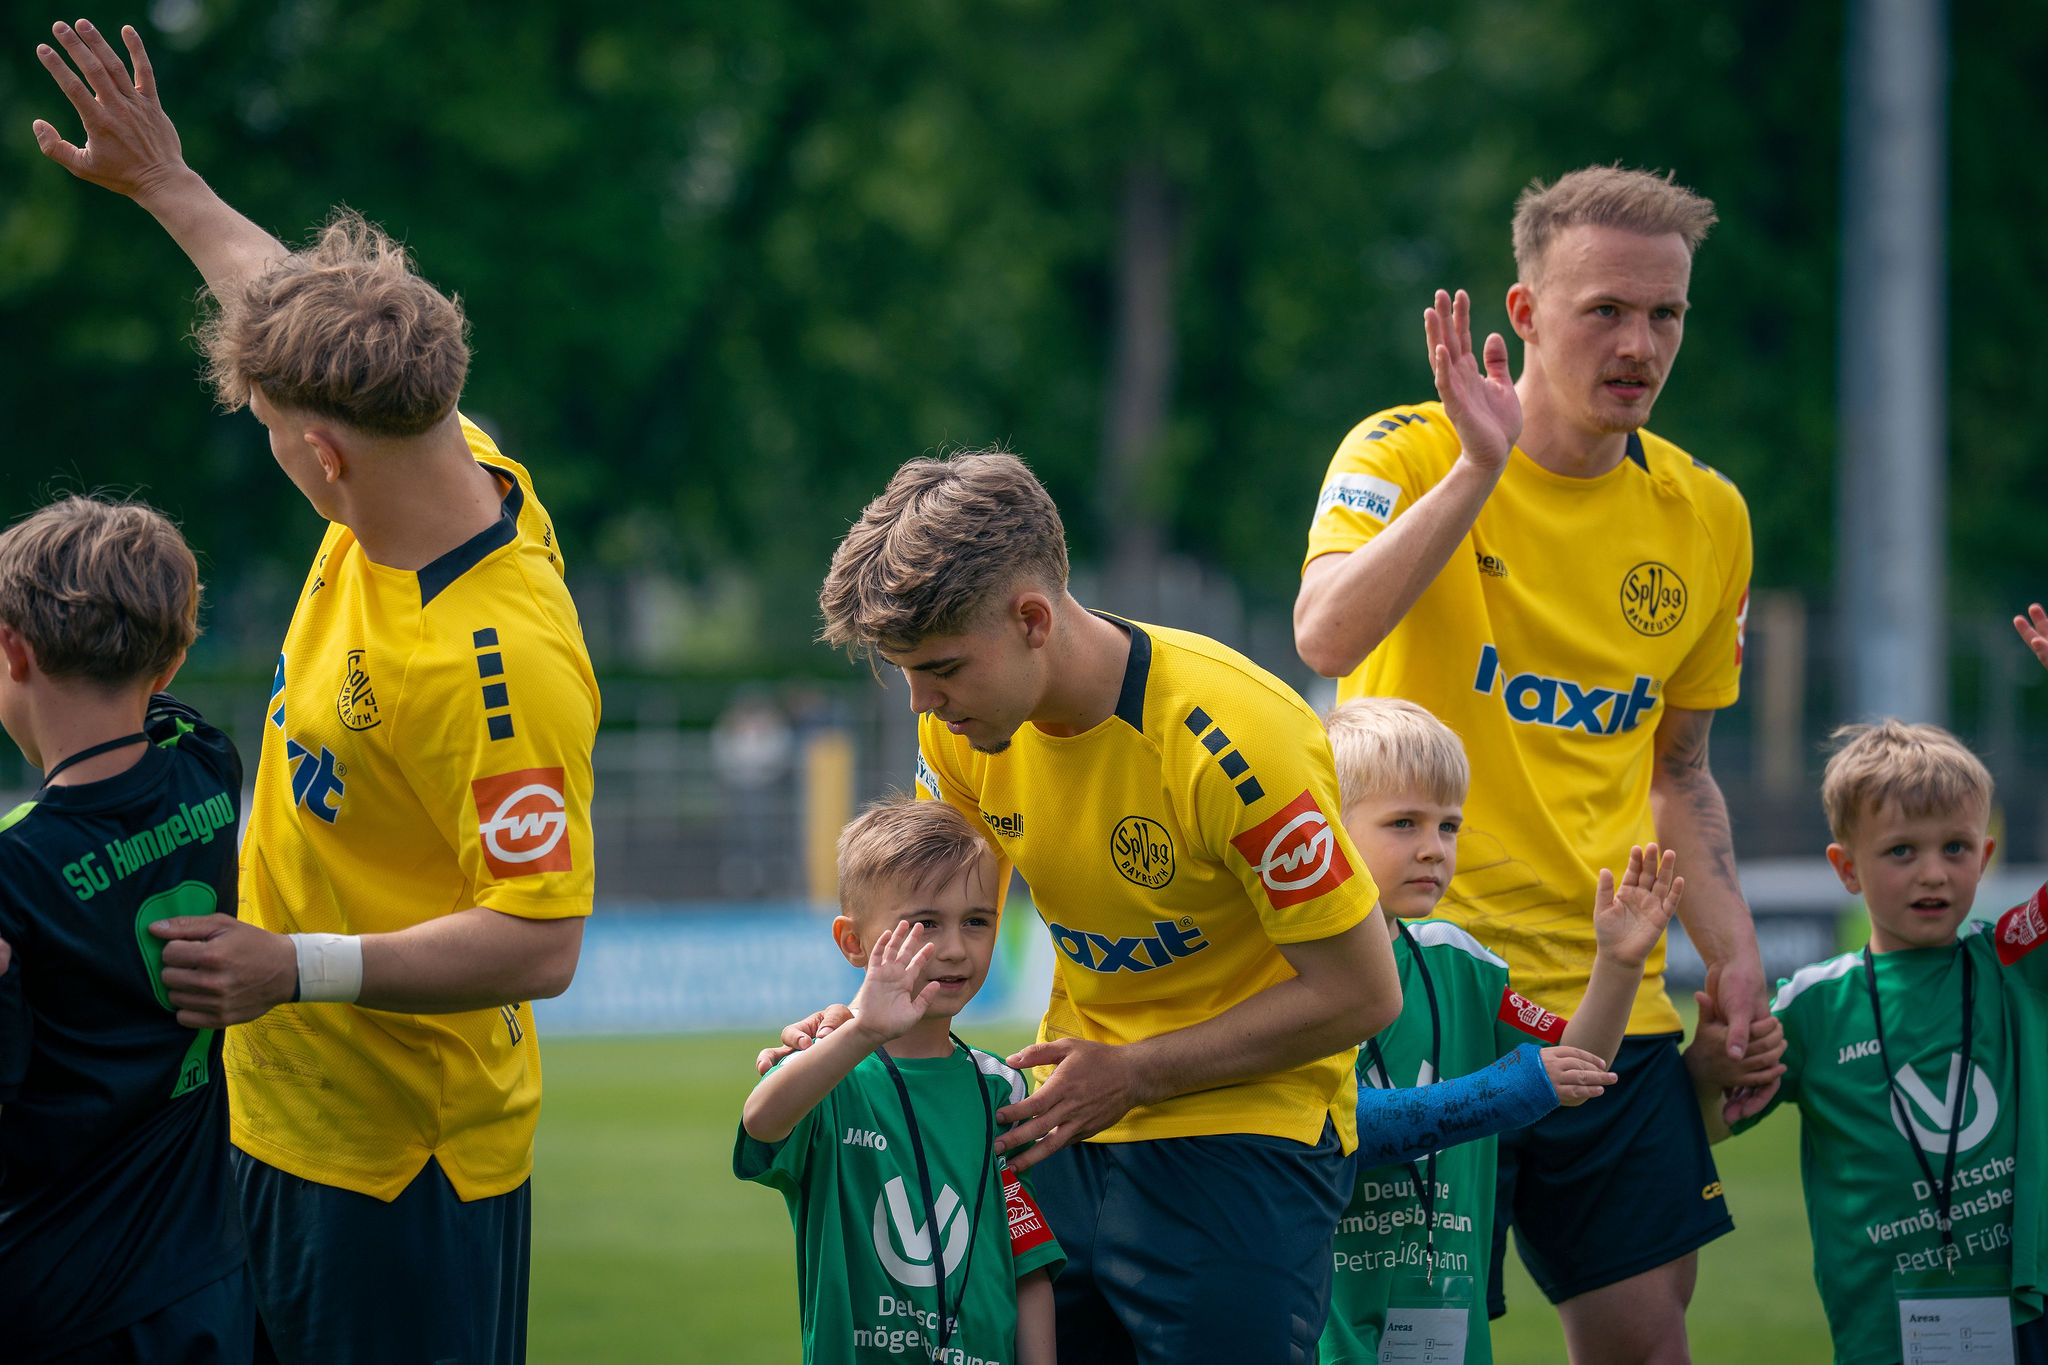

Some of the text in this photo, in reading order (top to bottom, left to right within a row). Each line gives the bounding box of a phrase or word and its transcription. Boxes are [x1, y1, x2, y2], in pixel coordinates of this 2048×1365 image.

[1627, 607, 1678, 632] BAYREUTH
[62, 791, 236, 901] SG Hummelgau
[1115, 821, 1170, 874] SpVgg
[1121, 860, 1169, 885] BAYREUTH
[1046, 918, 1212, 974] axit
[1837, 1038, 1881, 1065] JAKO
[842, 1127, 888, 1152] JAKO
[1333, 1249, 1397, 1273] Petra
[1386, 1322, 1413, 1332] Areas
